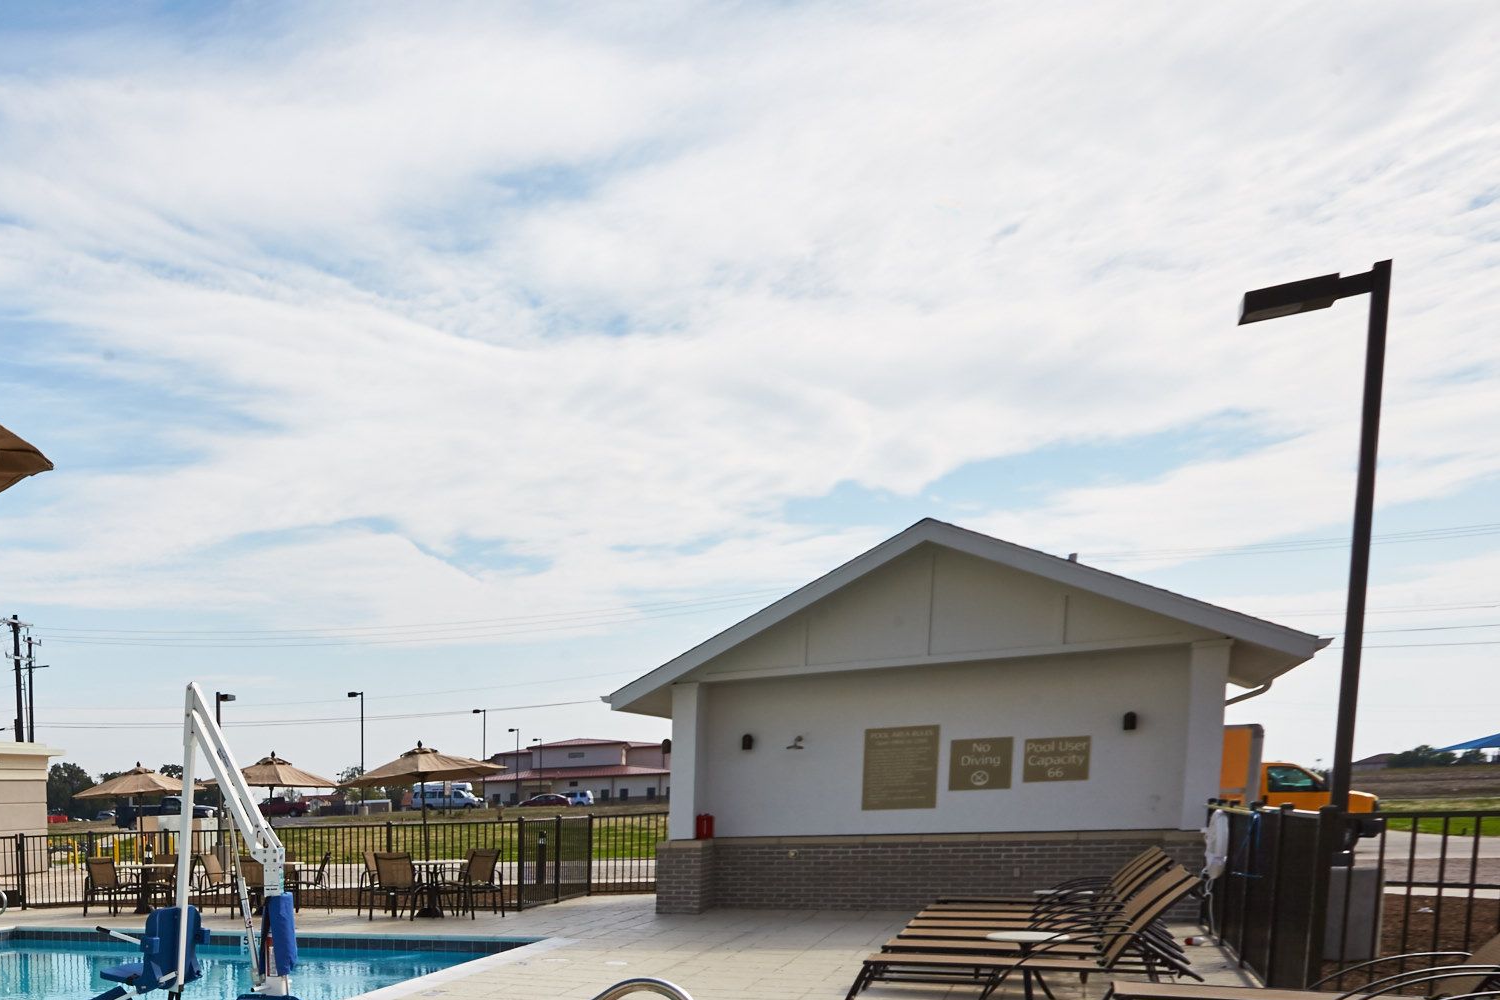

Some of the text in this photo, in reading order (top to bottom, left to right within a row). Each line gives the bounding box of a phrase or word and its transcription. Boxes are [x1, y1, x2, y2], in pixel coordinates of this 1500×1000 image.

[972, 743, 991, 753] No
[1026, 740, 1087, 753] Pool User
[961, 754, 1001, 767] Diving
[1027, 753, 1085, 767] Capacity
[1047, 768, 1064, 778] 66
